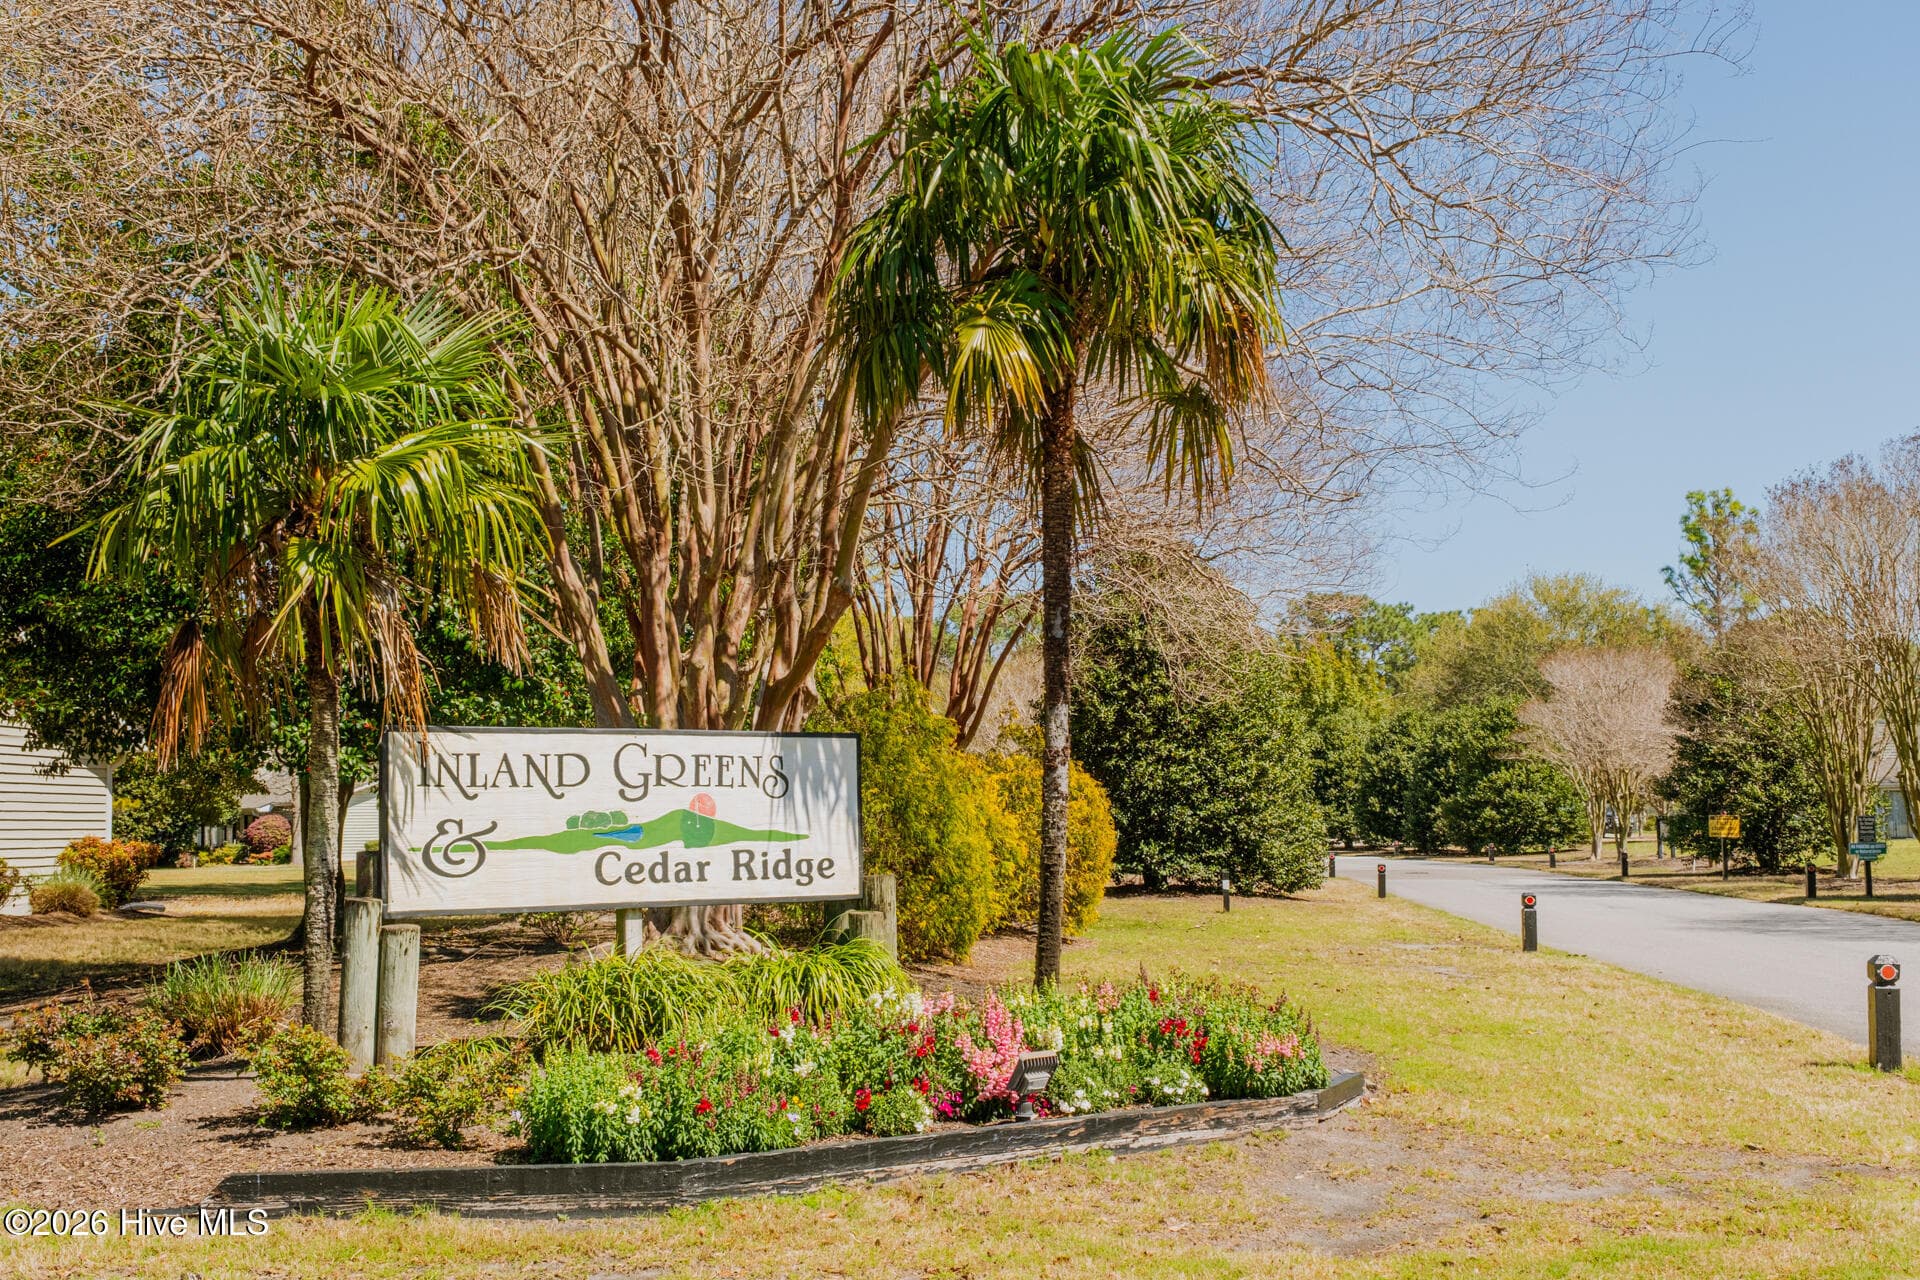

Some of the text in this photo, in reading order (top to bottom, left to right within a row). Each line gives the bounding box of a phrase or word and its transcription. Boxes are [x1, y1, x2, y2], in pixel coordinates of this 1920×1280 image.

[417, 741, 790, 802] INLAND GREENS
[421, 818, 498, 878] &
[594, 848, 836, 887] Cedar Ridge
